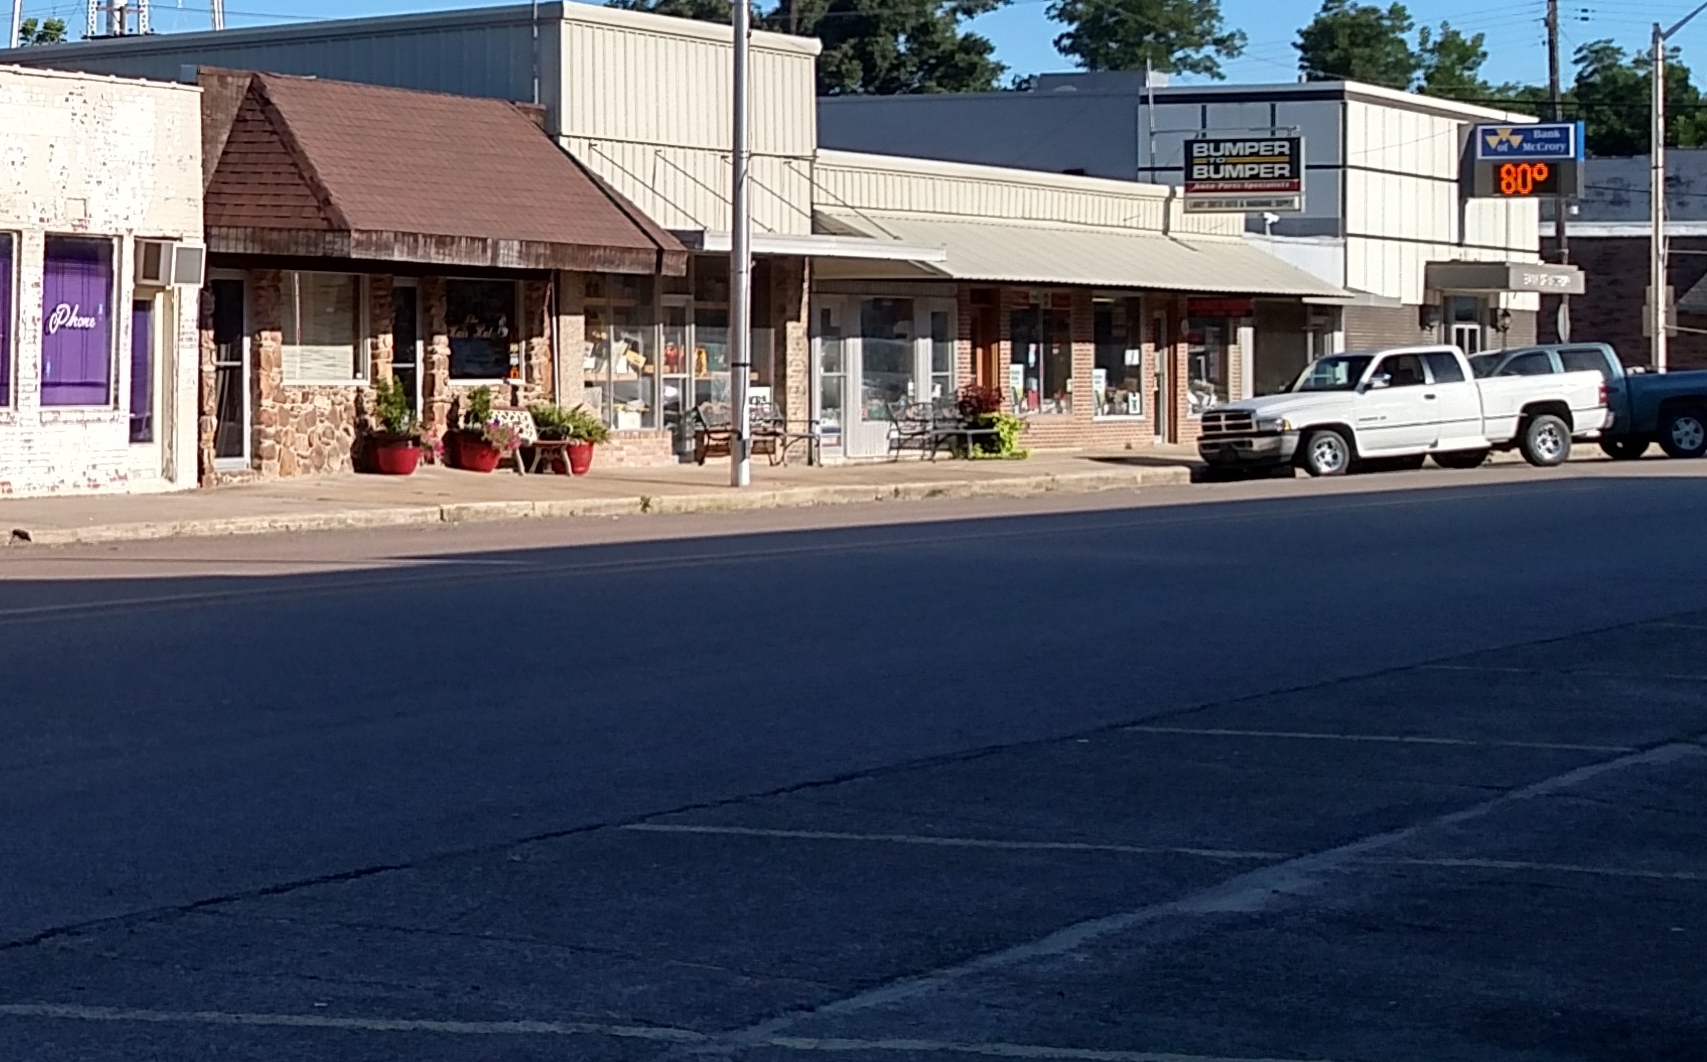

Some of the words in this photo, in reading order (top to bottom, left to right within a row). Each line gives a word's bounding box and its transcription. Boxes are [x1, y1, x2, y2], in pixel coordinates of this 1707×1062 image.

[1533, 129, 1561, 139] Bank
[1193, 141, 1291, 157] BUMPER
[1497, 143, 1508, 152] of
[1522, 142, 1567, 153] McCrory
[1193, 163, 1291, 179] BUMPER
[49, 303, 96, 334] Phone
